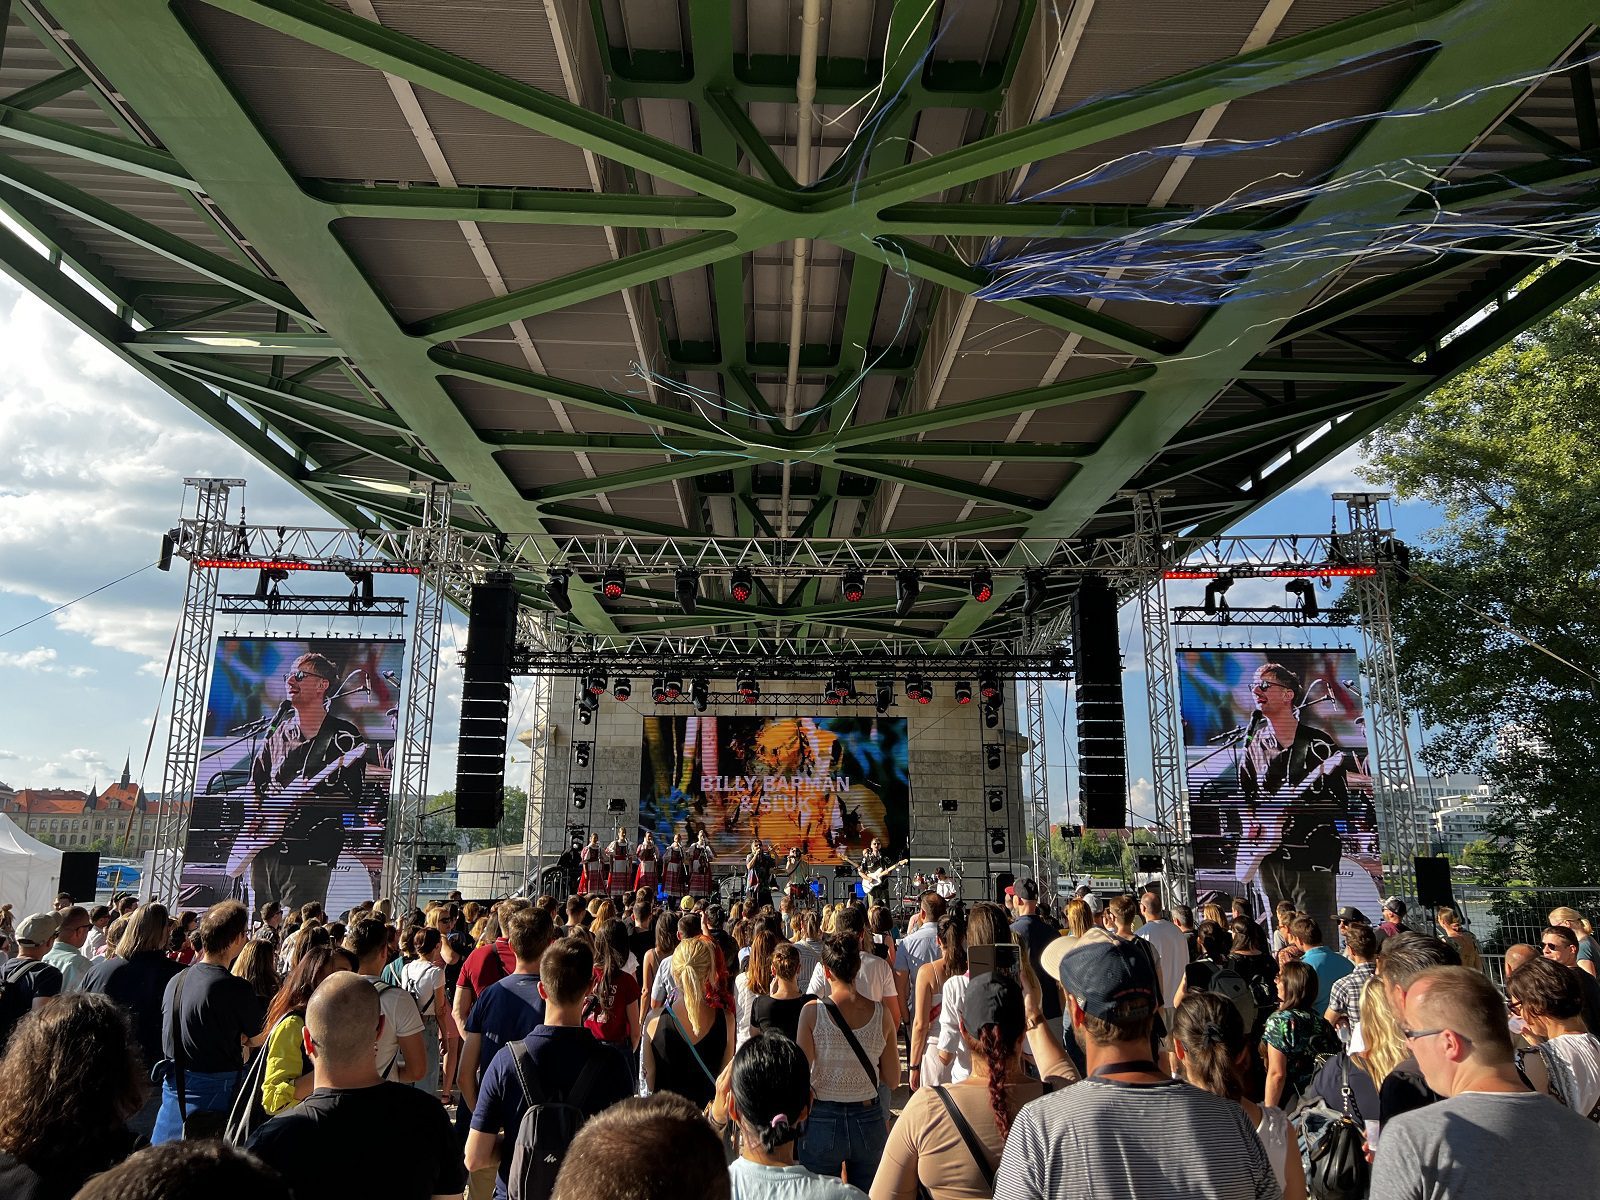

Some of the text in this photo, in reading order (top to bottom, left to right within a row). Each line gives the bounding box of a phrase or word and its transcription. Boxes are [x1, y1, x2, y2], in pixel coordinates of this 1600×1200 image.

[700, 775, 850, 792] BILLY BARMAN
[740, 795, 753, 812] &
